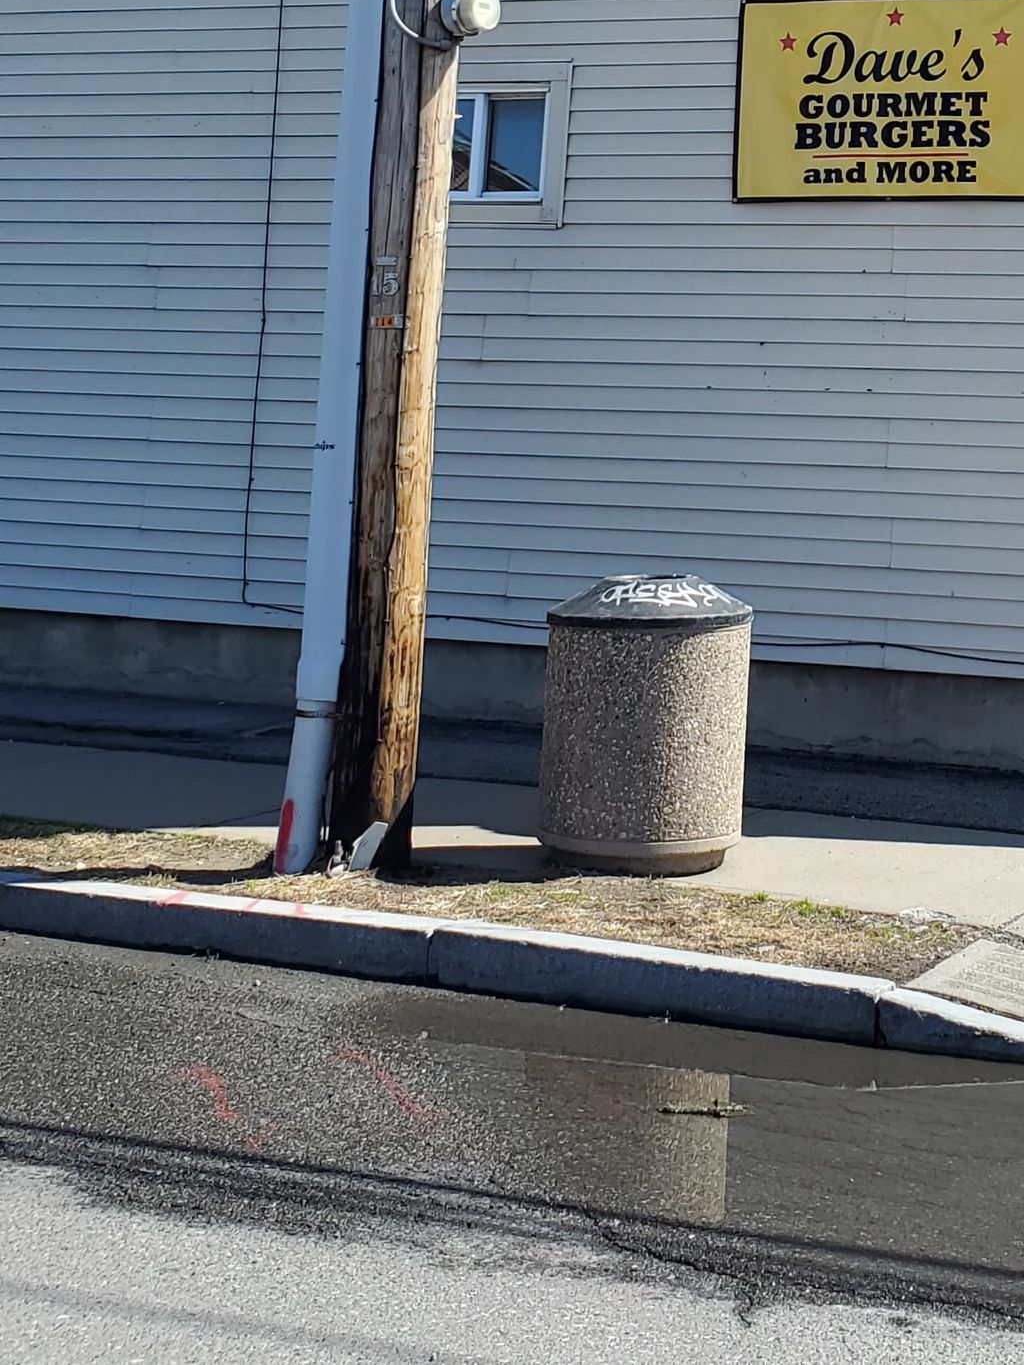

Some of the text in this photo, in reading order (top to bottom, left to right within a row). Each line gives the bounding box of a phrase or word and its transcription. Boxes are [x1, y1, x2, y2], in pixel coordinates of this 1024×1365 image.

[802, 28, 985, 84] Dave's
[799, 91, 988, 119] GOURMET
[794, 120, 991, 150] BURGERS
[803, 160, 977, 184] and MORE
